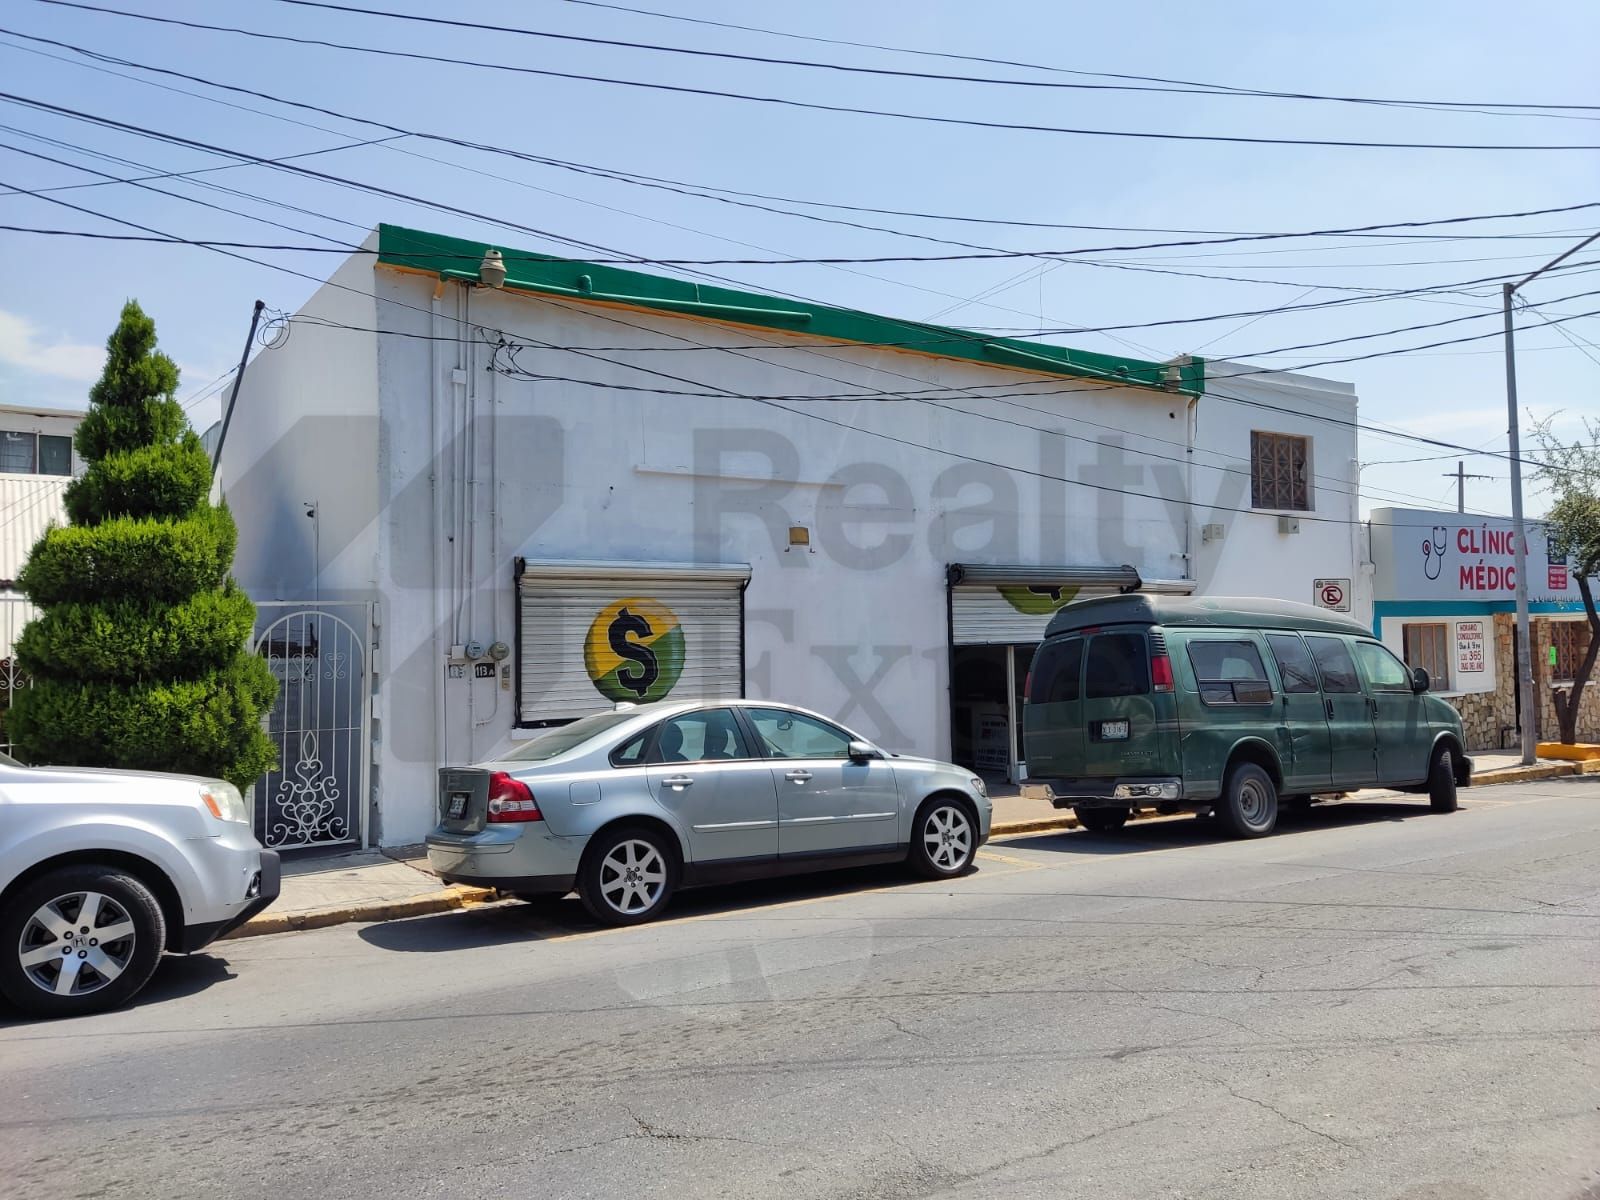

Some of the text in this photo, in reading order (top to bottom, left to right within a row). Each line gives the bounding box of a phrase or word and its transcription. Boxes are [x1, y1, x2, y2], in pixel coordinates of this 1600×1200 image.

[1457, 523, 1529, 556] CLÍNIC
[1460, 559, 1517, 591] MÉDIC
[1469, 651, 1481, 661] 365
